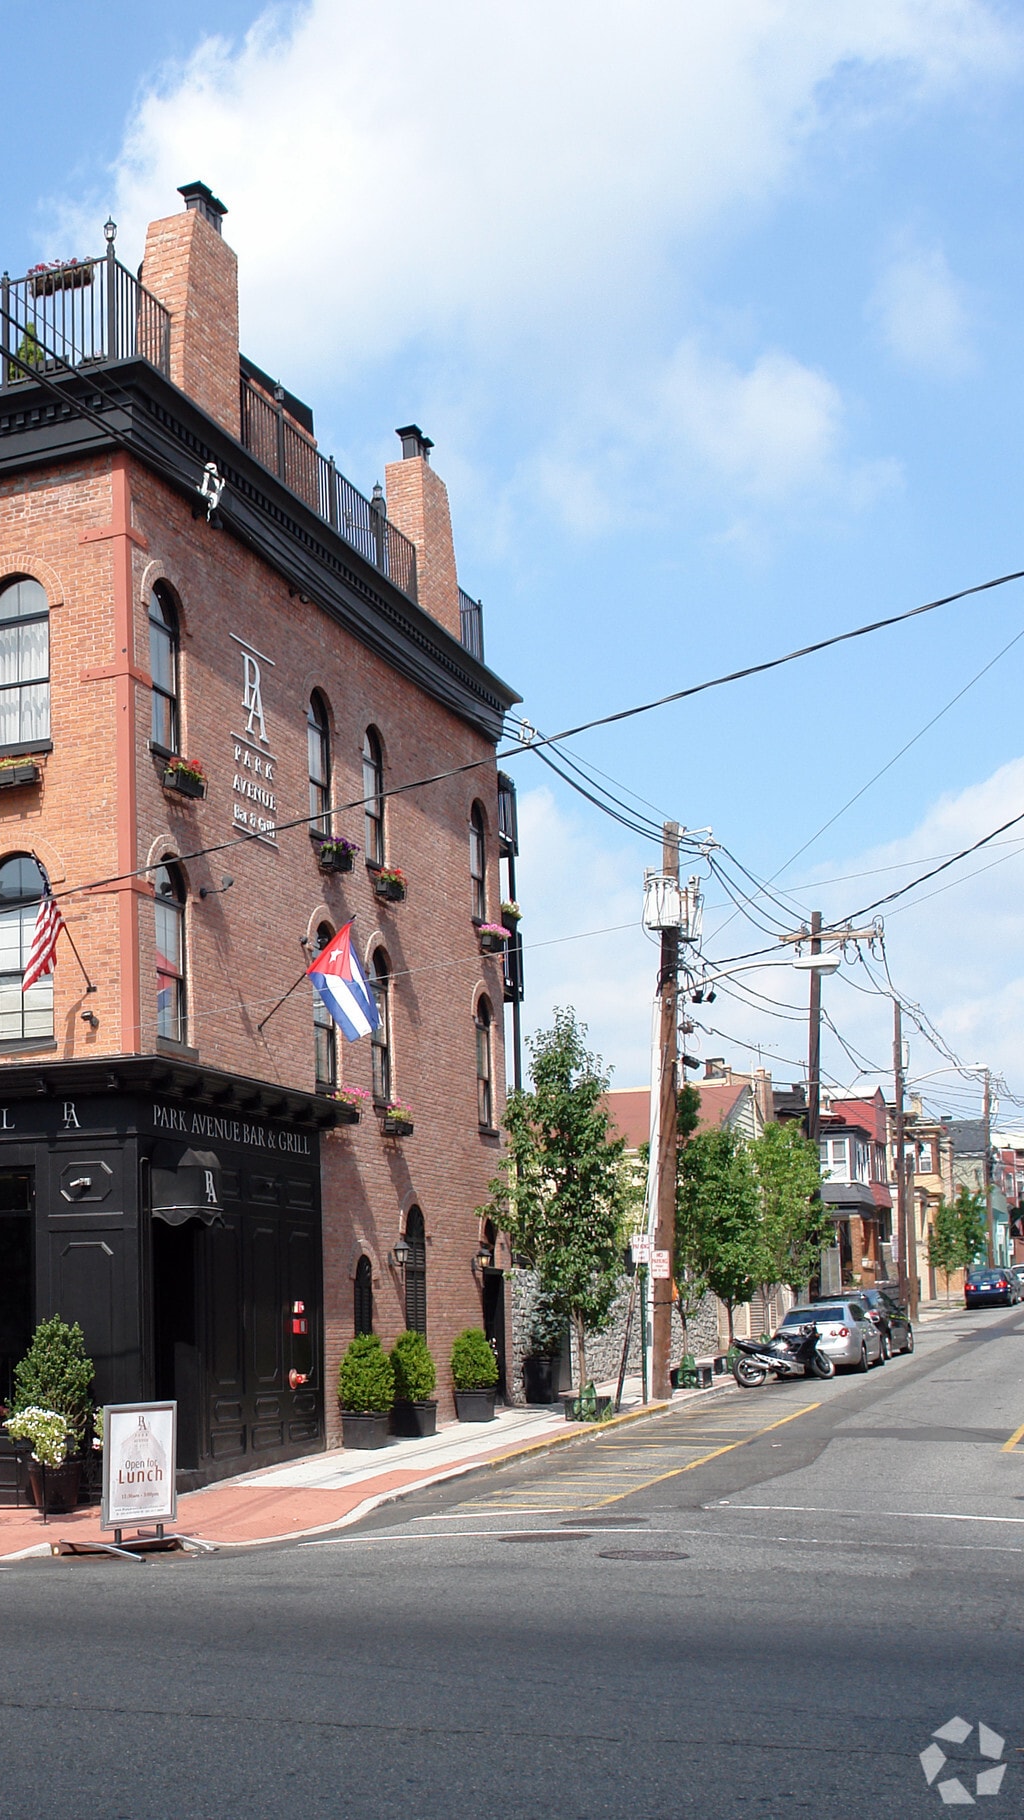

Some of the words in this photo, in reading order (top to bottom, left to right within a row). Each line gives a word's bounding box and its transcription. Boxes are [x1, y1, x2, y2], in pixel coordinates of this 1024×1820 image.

[233, 743, 274, 781] PARK
[232, 773, 277, 811] AVENUE
[152, 1104, 188, 1132] PARK
[190, 1112, 241, 1143] AVENUE
[242, 1123, 266, 1148] BAR
[267, 1129, 276, 1149] &
[278, 1131, 311, 1156] GRILL
[118, 1465, 163, 1485] Lunch
[125, 1460, 145, 1471] Open
[147, 1458, 158, 1468] for
